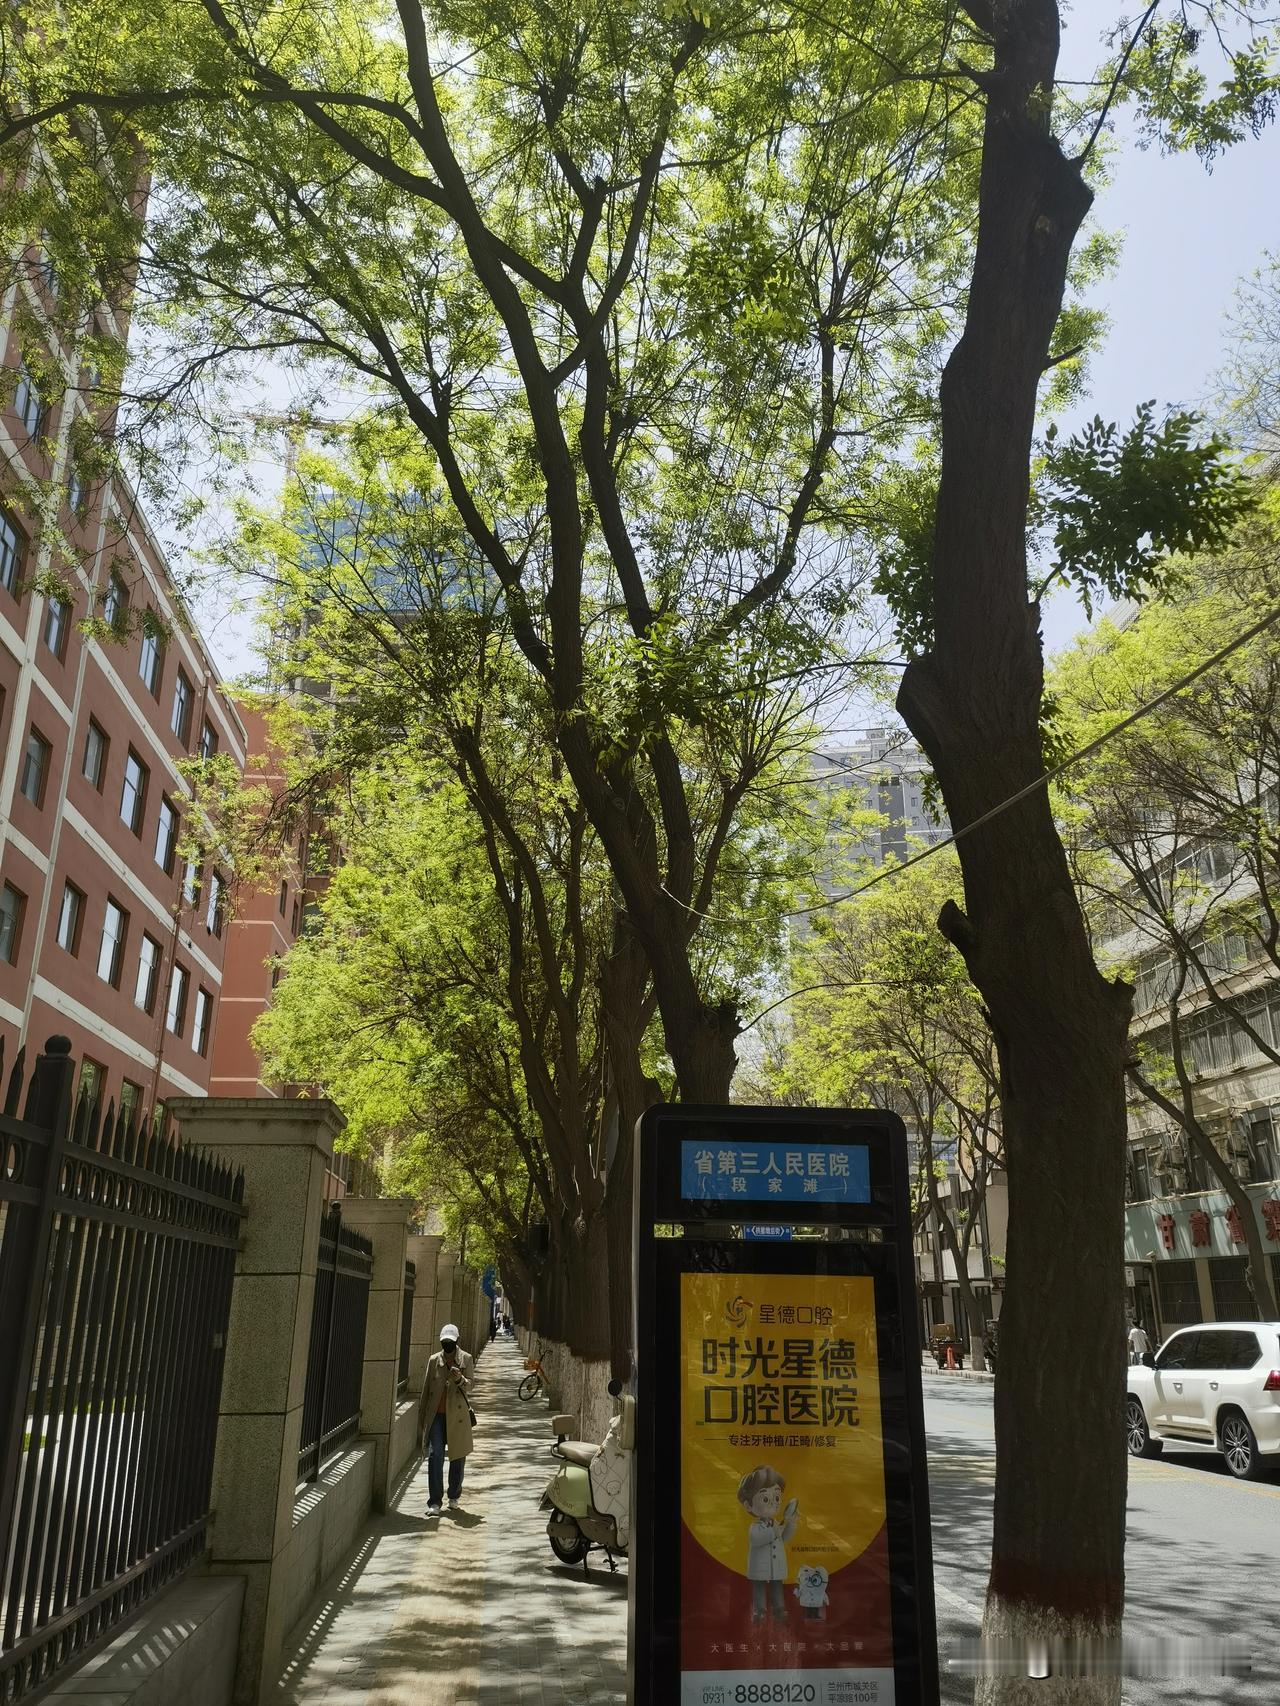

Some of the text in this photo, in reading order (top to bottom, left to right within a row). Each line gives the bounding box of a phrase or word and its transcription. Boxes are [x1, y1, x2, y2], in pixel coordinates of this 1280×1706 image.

[694, 1150, 850, 1178] 省第三人民医院
[760, 1304, 833, 1326] 星德口腔
[702, 1337, 857, 1380] 时光星德
[704, 1384, 859, 1427] 口腔医院
[703, 1684, 816, 1704] 0931 8888120
[827, 1681, 878, 1691] 兰州市城关区
[828, 1693, 878, 1703] 平凉路100号
